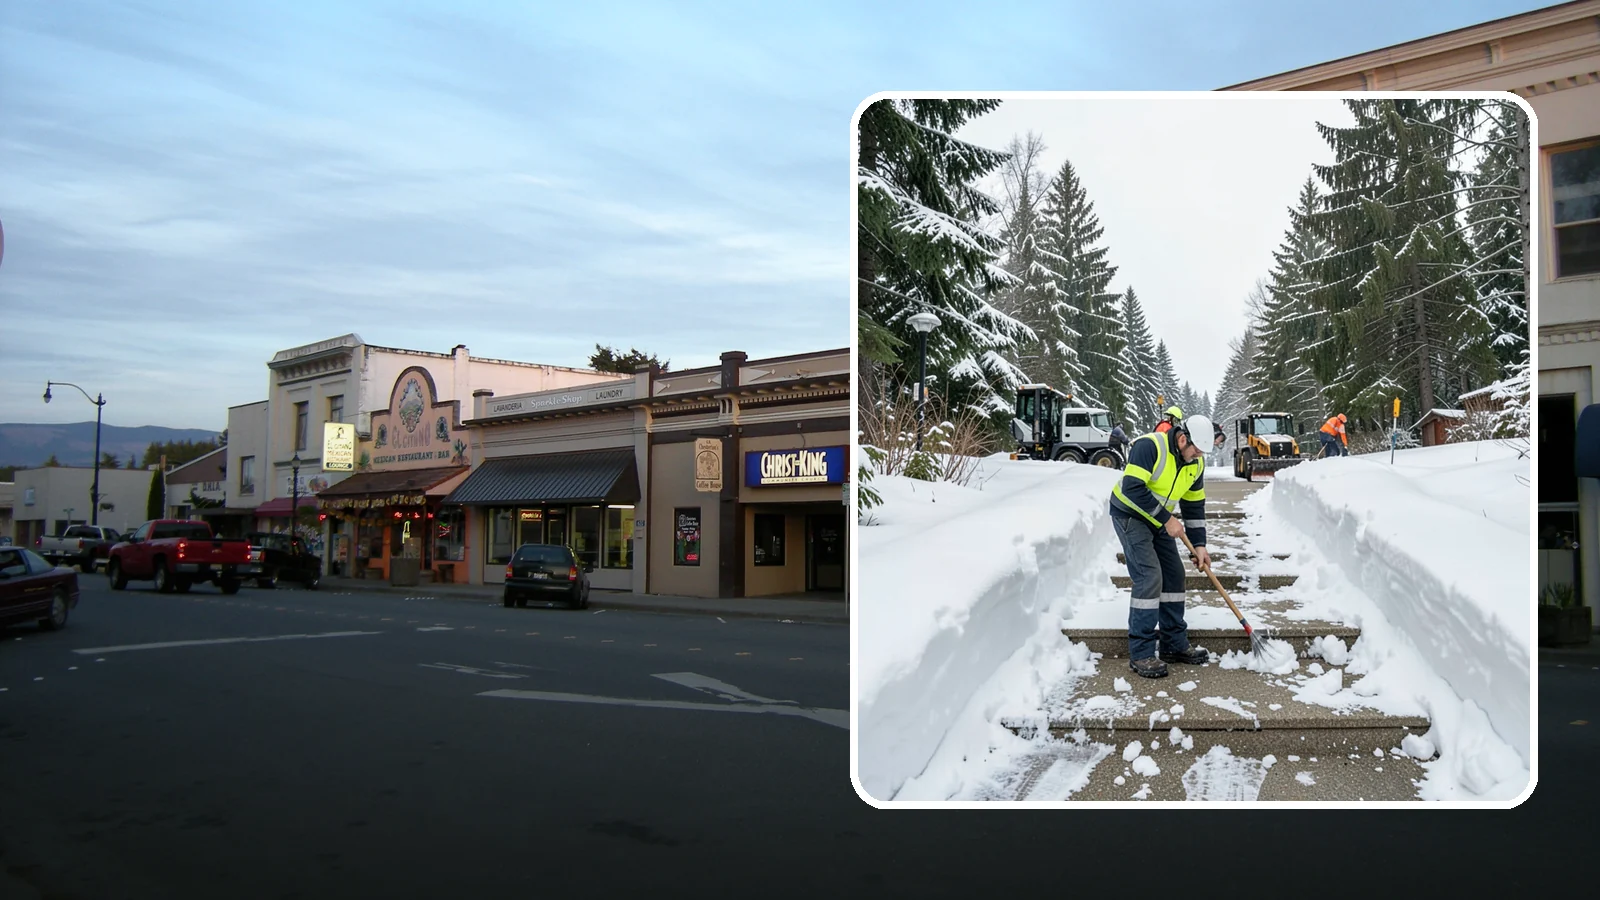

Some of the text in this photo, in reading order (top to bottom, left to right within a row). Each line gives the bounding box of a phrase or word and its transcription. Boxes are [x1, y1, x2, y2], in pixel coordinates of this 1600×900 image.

[494, 389, 624, 412] LAVANDERIA Sparkle Shop LAUNDRY
[392, 425, 402, 449] EL
[373, 455, 396, 464] MEXICAN
[397, 451, 433, 462] RESTAURANT
[437, 450, 450, 459] BAR
[761, 450, 828, 478] CHRIST KING
